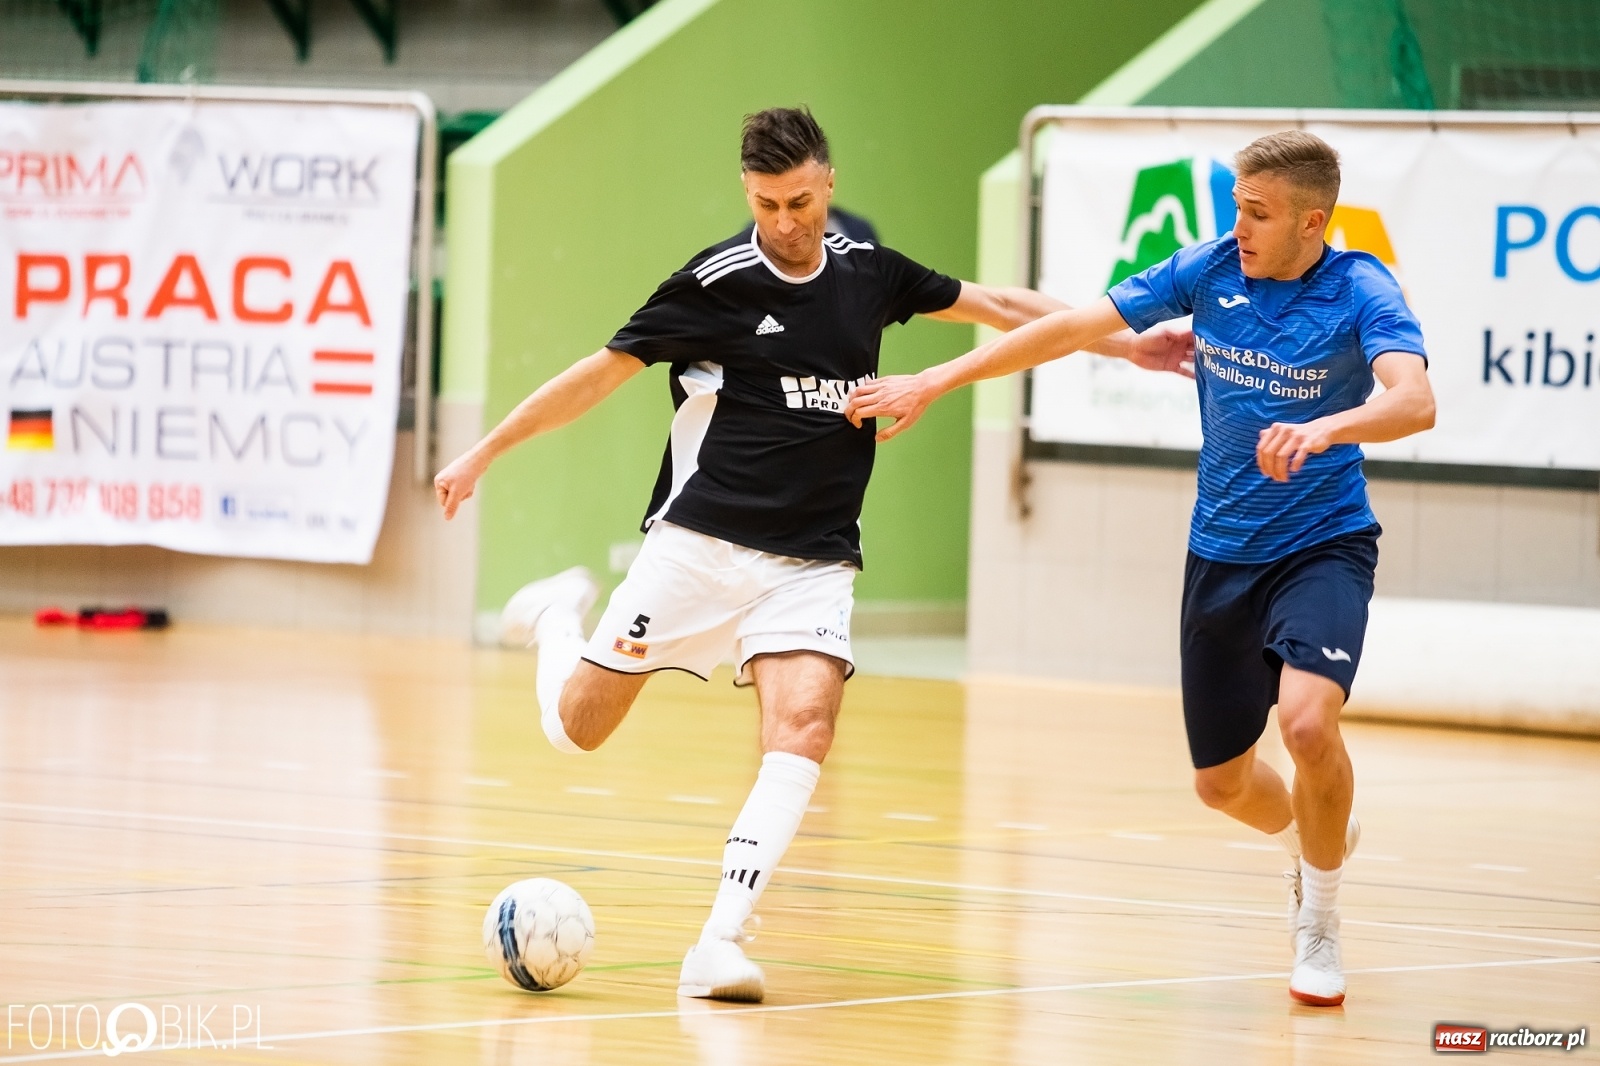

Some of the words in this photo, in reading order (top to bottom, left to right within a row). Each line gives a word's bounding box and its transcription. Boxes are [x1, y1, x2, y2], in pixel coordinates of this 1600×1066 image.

[217, 152, 381, 197] WORK
[1494, 205, 1600, 283] PO
[14, 253, 373, 328] PRACA
[755, 325, 785, 336] adidas
[9, 336, 298, 395] AUSTRIA
[1195, 335, 1329, 381] Marek&Dariusz
[1203, 353, 1266, 390] Metallbau
[1269, 380, 1321, 400] GmbH
[1482, 328, 1600, 388] kibi
[69, 405, 369, 467] NIEMCY
[628, 613, 651, 639] 5
